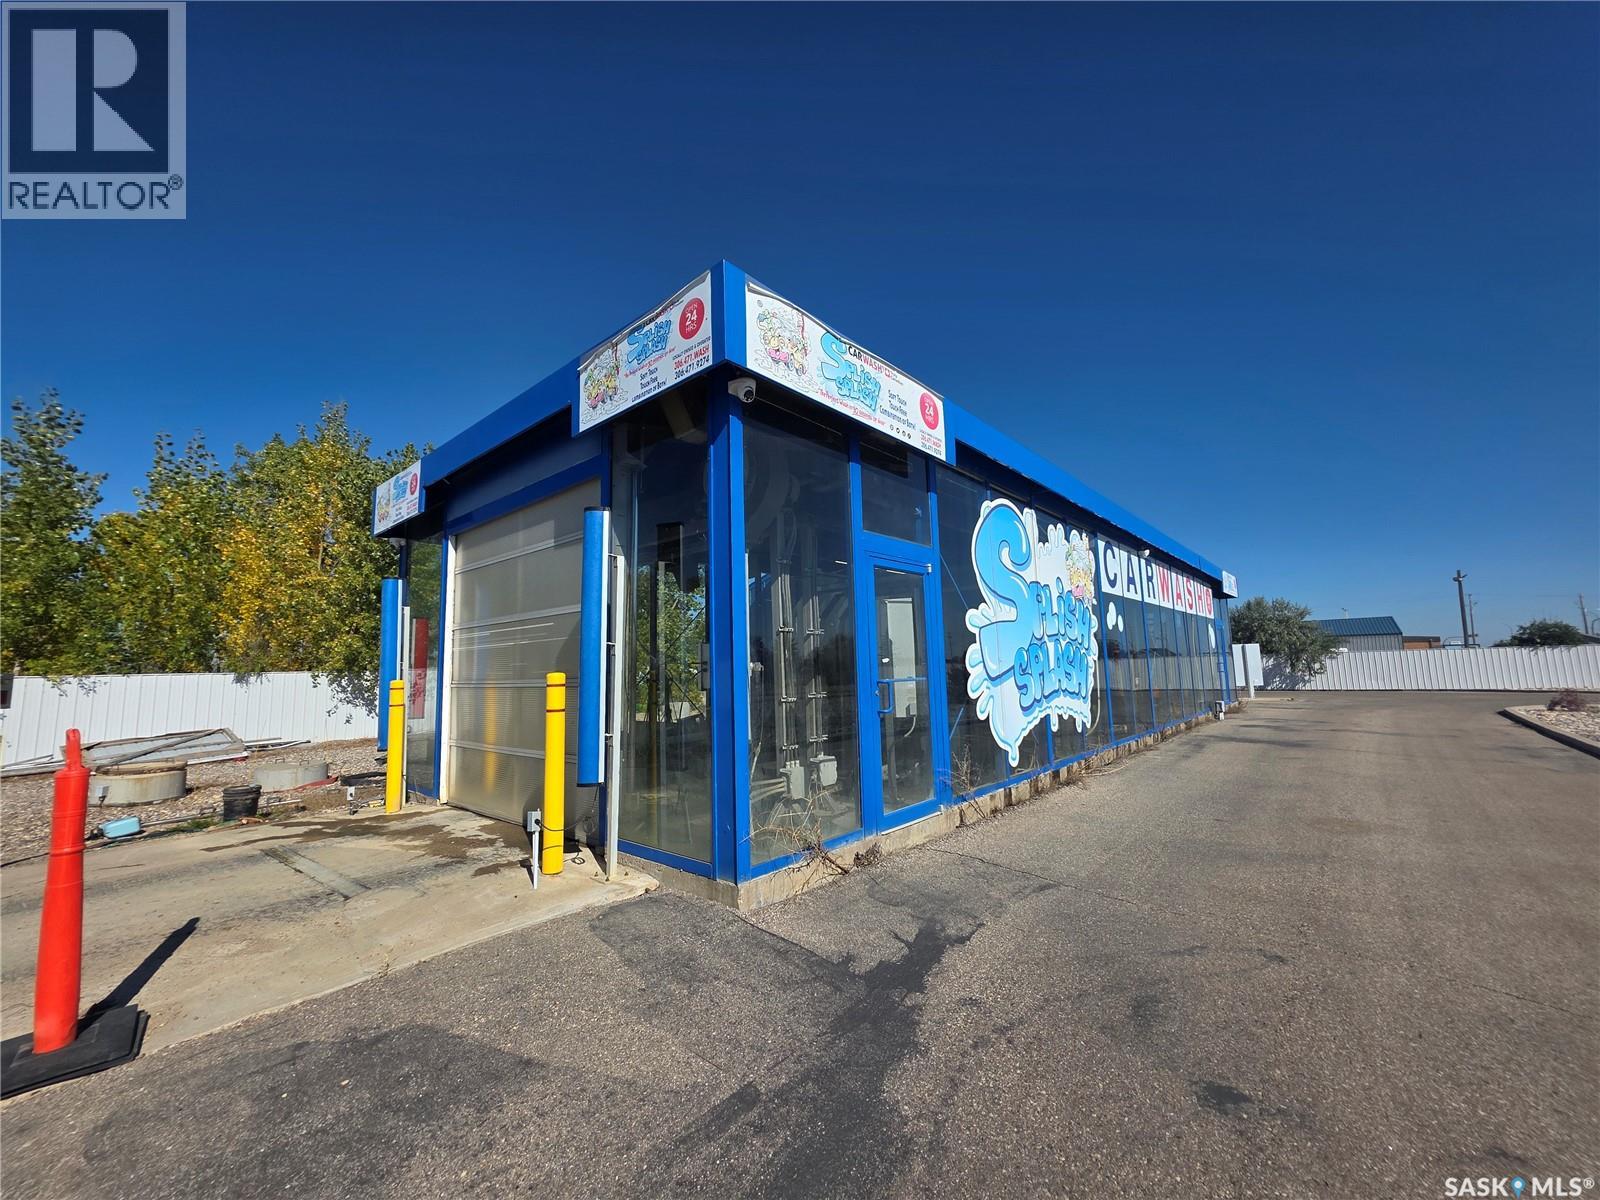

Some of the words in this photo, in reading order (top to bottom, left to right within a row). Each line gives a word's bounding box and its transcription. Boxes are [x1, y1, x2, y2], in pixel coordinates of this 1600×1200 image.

[685, 309, 698, 326] 24
[685, 322, 698, 334] HRS
[924, 402, 934, 417] 24
[1013, 647, 1089, 713] SPLASH
